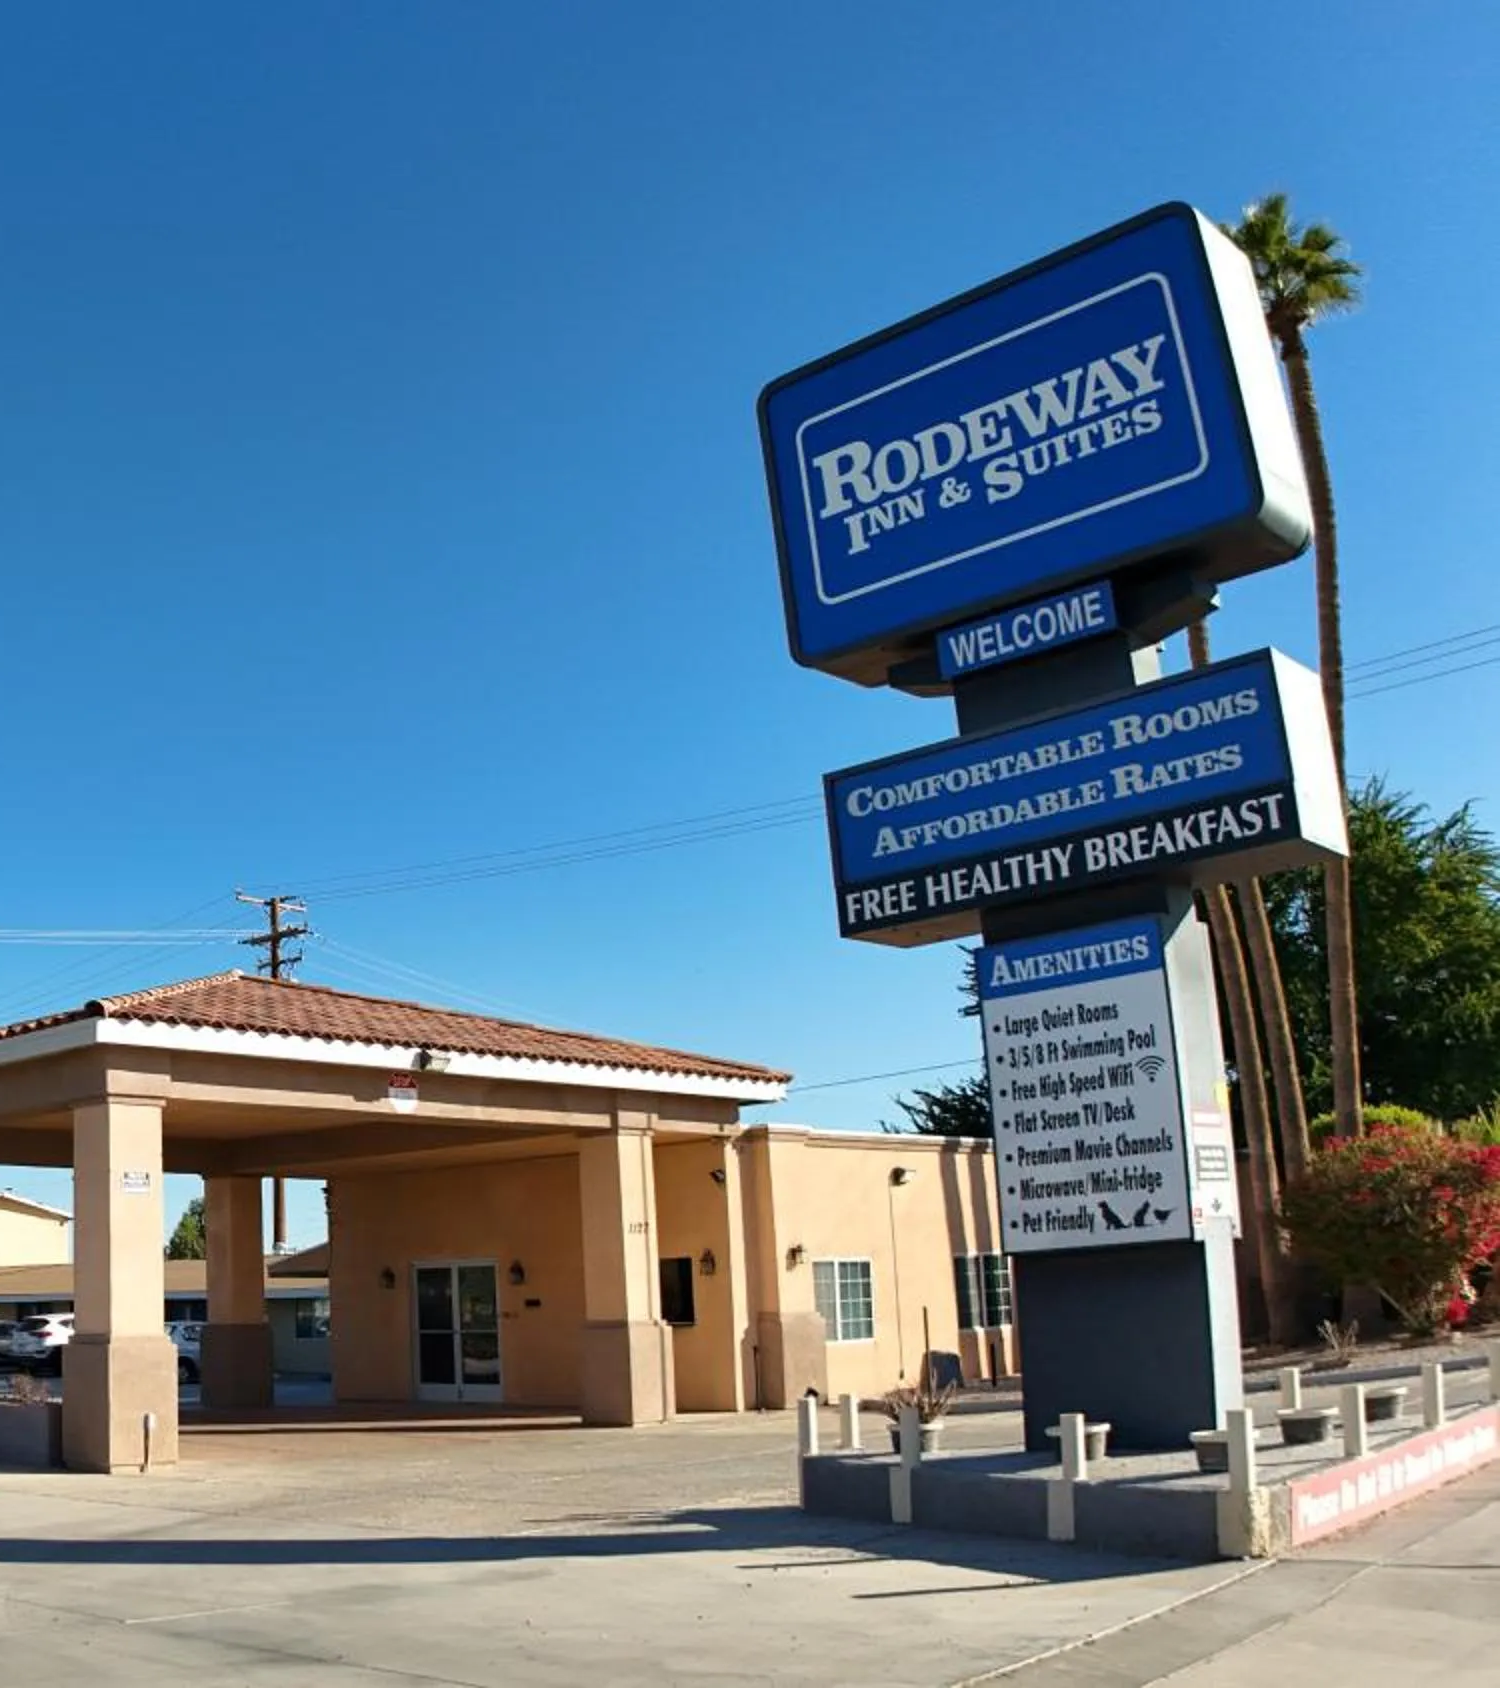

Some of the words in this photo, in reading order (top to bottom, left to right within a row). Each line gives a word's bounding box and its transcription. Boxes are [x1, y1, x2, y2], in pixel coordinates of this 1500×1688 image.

[813, 335, 1166, 518] RODEWAY
[844, 494, 926, 555] INN
[939, 477, 971, 509] &
[984, 400, 1163, 503] SUITES
[948, 591, 1104, 668] WELCOME
[846, 730, 1104, 817] COMFORTABLE
[1110, 688, 1259, 750] ROOMS
[872, 778, 1105, 858] AFFORDABLE
[1112, 744, 1244, 799] RATES
[845, 883, 917, 924] FREE
[926, 843, 1073, 907] HEALTHY
[1085, 793, 1285, 873] BREAKFAST
[990, 935, 1149, 987] AMENITIES
[1004, 1015, 1039, 1037] Large
[1041, 1005, 1074, 1031] Quiet
[1076, 1003, 1119, 1025] Rooms
[1008, 1043, 1044, 1070] 3/5/8
[1047, 1041, 1059, 1062] Ft
[1061, 1035, 1125, 1060] Swimming
[1127, 1023, 1156, 1050] Pool
[1011, 1079, 1037, 1101] Free
[1039, 1072, 1066, 1100] High
[1069, 1066, 1105, 1097] Speed
[1014, 1111, 1037, 1134] Flat
[1040, 1109, 1080, 1131] Screen
[1017, 1141, 1072, 1167] Premium
[1074, 1136, 1113, 1161] Movie
[1115, 1127, 1173, 1157] Channels
[1022, 1212, 1043, 1234] Pet
[1045, 1204, 1095, 1233] Friendly
